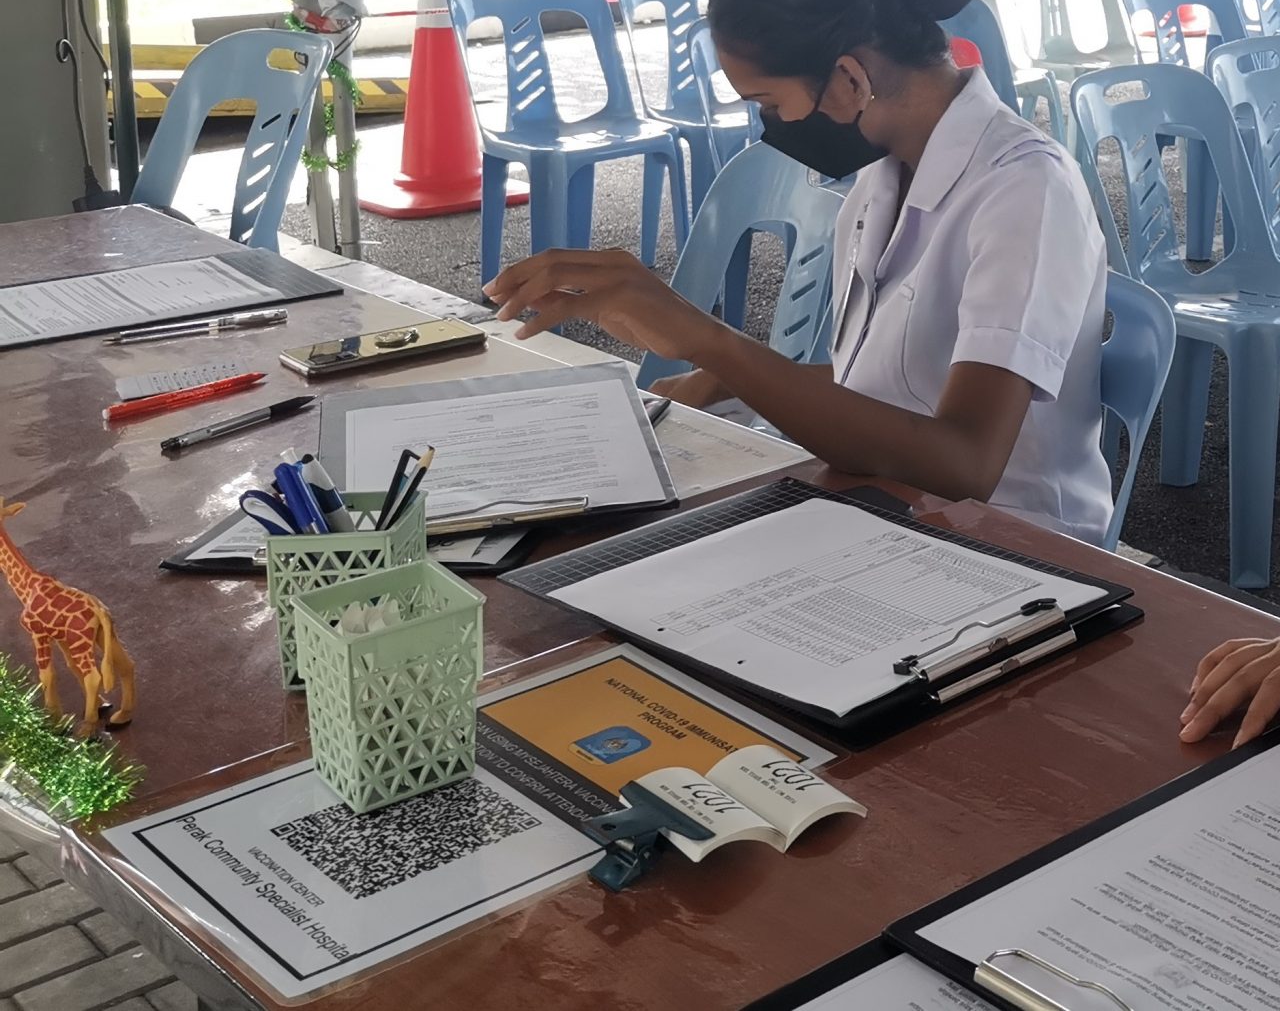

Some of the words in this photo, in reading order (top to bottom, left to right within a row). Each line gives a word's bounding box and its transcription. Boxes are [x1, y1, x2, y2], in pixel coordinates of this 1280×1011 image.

[605, 678, 649, 704] NATIONAL
[647, 702, 690, 726] COVID-19
[686, 724, 740, 754] IMMUNISAT
[638, 712, 688, 740] PROGRAM
[475, 742, 497, 761] TION
[493, 757, 508, 769] TO
[505, 764, 547, 795] CONFIRM
[543, 791, 592, 822] ATTENDA
[491, 732, 519, 753] USING
[514, 745, 578, 791] MYSEJAHTERA
[574, 785, 617, 813] VACCINA
[681, 782, 738, 815] 1021
[761, 759, 824, 791] 1021
[176, 815, 213, 843] Perak
[203, 838, 264, 886] Community
[255, 881, 313, 927] Specialist
[247, 846, 296, 885] VACCINATION
[290, 882, 325, 908] CENTER
